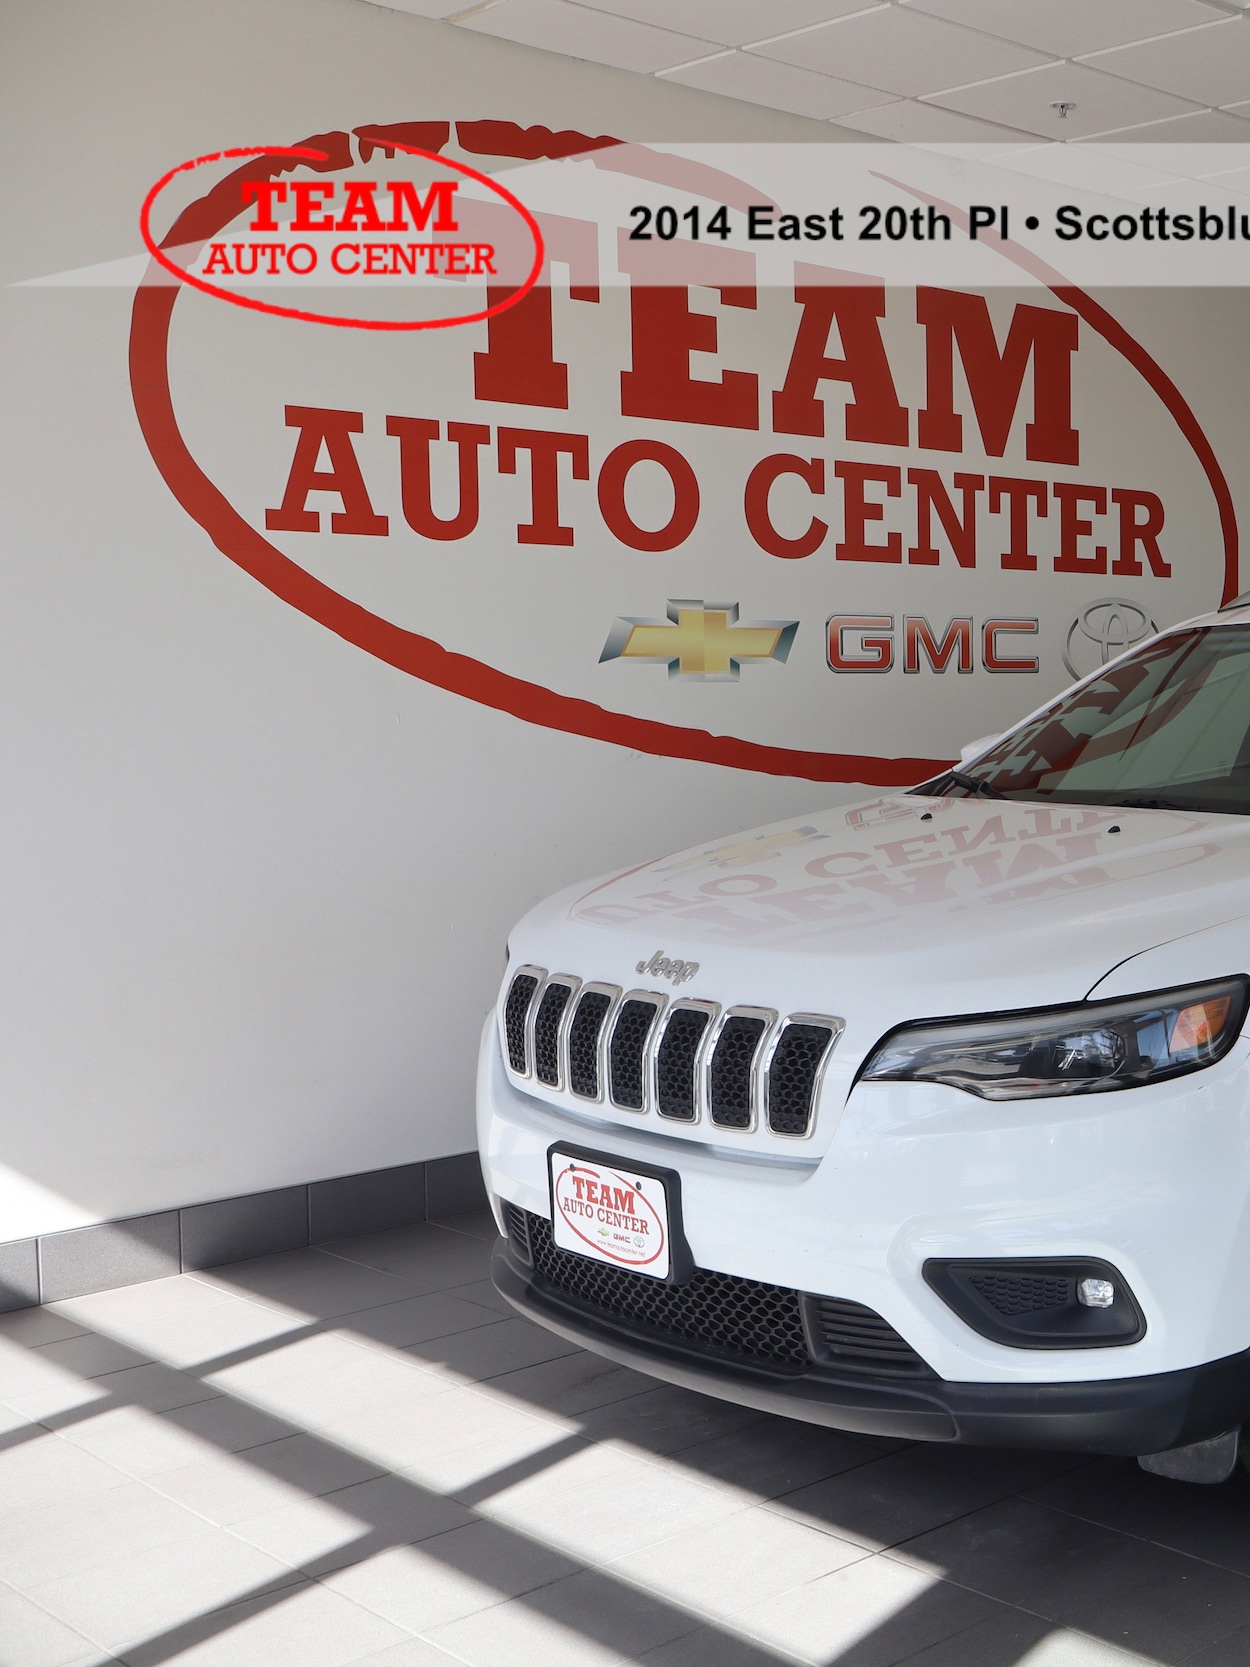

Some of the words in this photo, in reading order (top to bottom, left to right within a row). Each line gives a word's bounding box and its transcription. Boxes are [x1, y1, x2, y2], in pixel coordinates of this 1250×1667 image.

[432, 190, 1079, 466] TEAM
[265, 404, 700, 552] AUTO
[744, 452, 1172, 578] CENTER
[825, 611, 1040, 674] GMC
[635, 949, 700, 987] Jeep
[572, 1175, 636, 1215] TEAM
[563, 1197, 594, 1219] AUTO
[597, 1207, 650, 1235] CENTER
[613, 1233, 631, 1244] GMC
